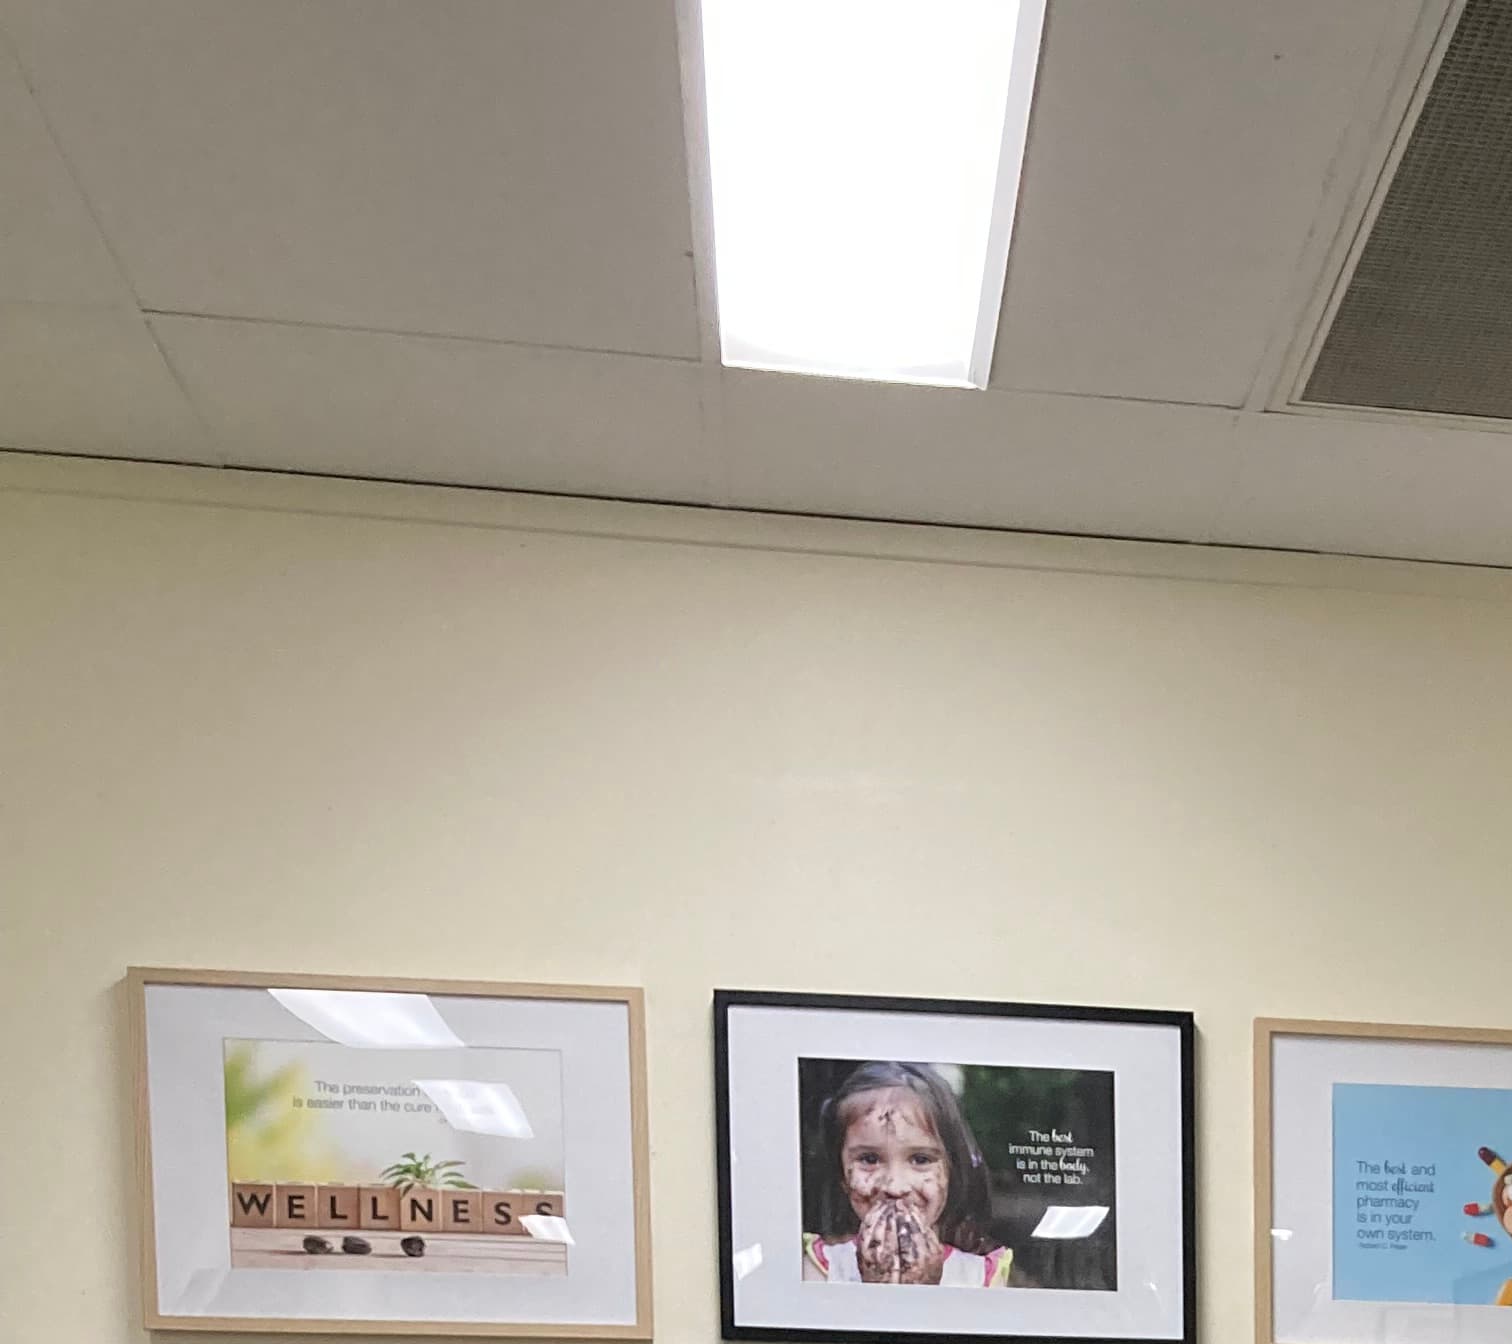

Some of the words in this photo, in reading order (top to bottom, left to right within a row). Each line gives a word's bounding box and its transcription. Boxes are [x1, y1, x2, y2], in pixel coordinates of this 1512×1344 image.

[315, 1080, 339, 1094] The
[343, 1081, 420, 1098] preservation
[306, 1098, 344, 1110] easier
[348, 1099, 377, 1112] than
[380, 1100, 401, 1112] the
[404, 1103, 432, 1113] cure
[1028, 1130, 1050, 1142] The
[1008, 1143, 1053, 1156] immune
[1055, 1146, 1095, 1159] system
[1016, 1159, 1026, 1169] is
[1028, 1160, 1038, 1170] in
[1041, 1160, 1058, 1170] the
[1356, 1160, 1381, 1174] The
[1411, 1164, 1436, 1176] and
[1023, 1173, 1041, 1183] not
[1044, 1173, 1061, 1184] the
[1356, 1180, 1389, 1192] most
[1391, 1177, 1435, 1195] efficient
[237, 1192, 554, 1225] WELLNESS
[1356, 1196, 1420, 1212] pharmacy
[1357, 1213, 1367, 1223] is
[1370, 1213, 1382, 1224] in
[1386, 1214, 1413, 1226] your
[1357, 1228, 1384, 1239] own
